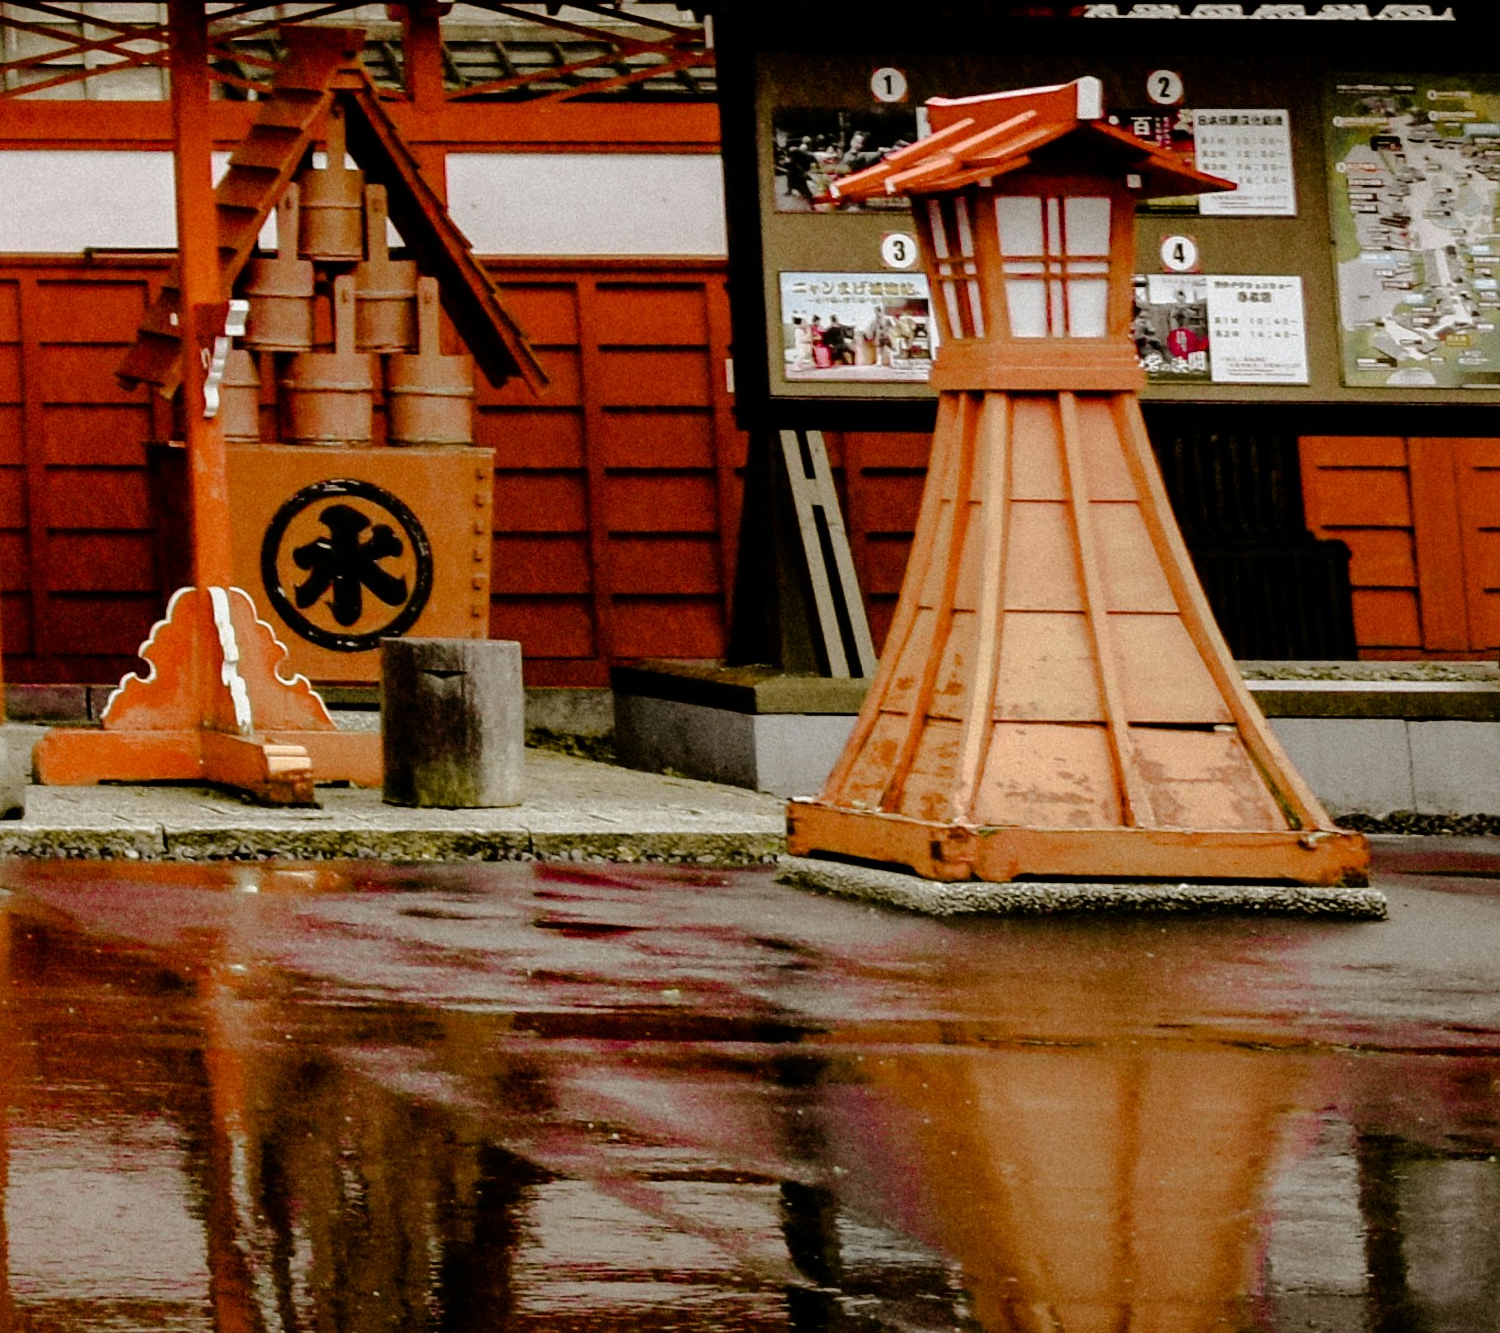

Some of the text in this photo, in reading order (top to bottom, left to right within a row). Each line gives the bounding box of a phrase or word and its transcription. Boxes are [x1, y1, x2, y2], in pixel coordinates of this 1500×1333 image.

[883, 74, 892, 95] 1
[1158, 76, 1171, 98] 2
[893, 240, 905, 262] 3
[1172, 242, 1185, 263] 4
[293, 504, 408, 626] 水
